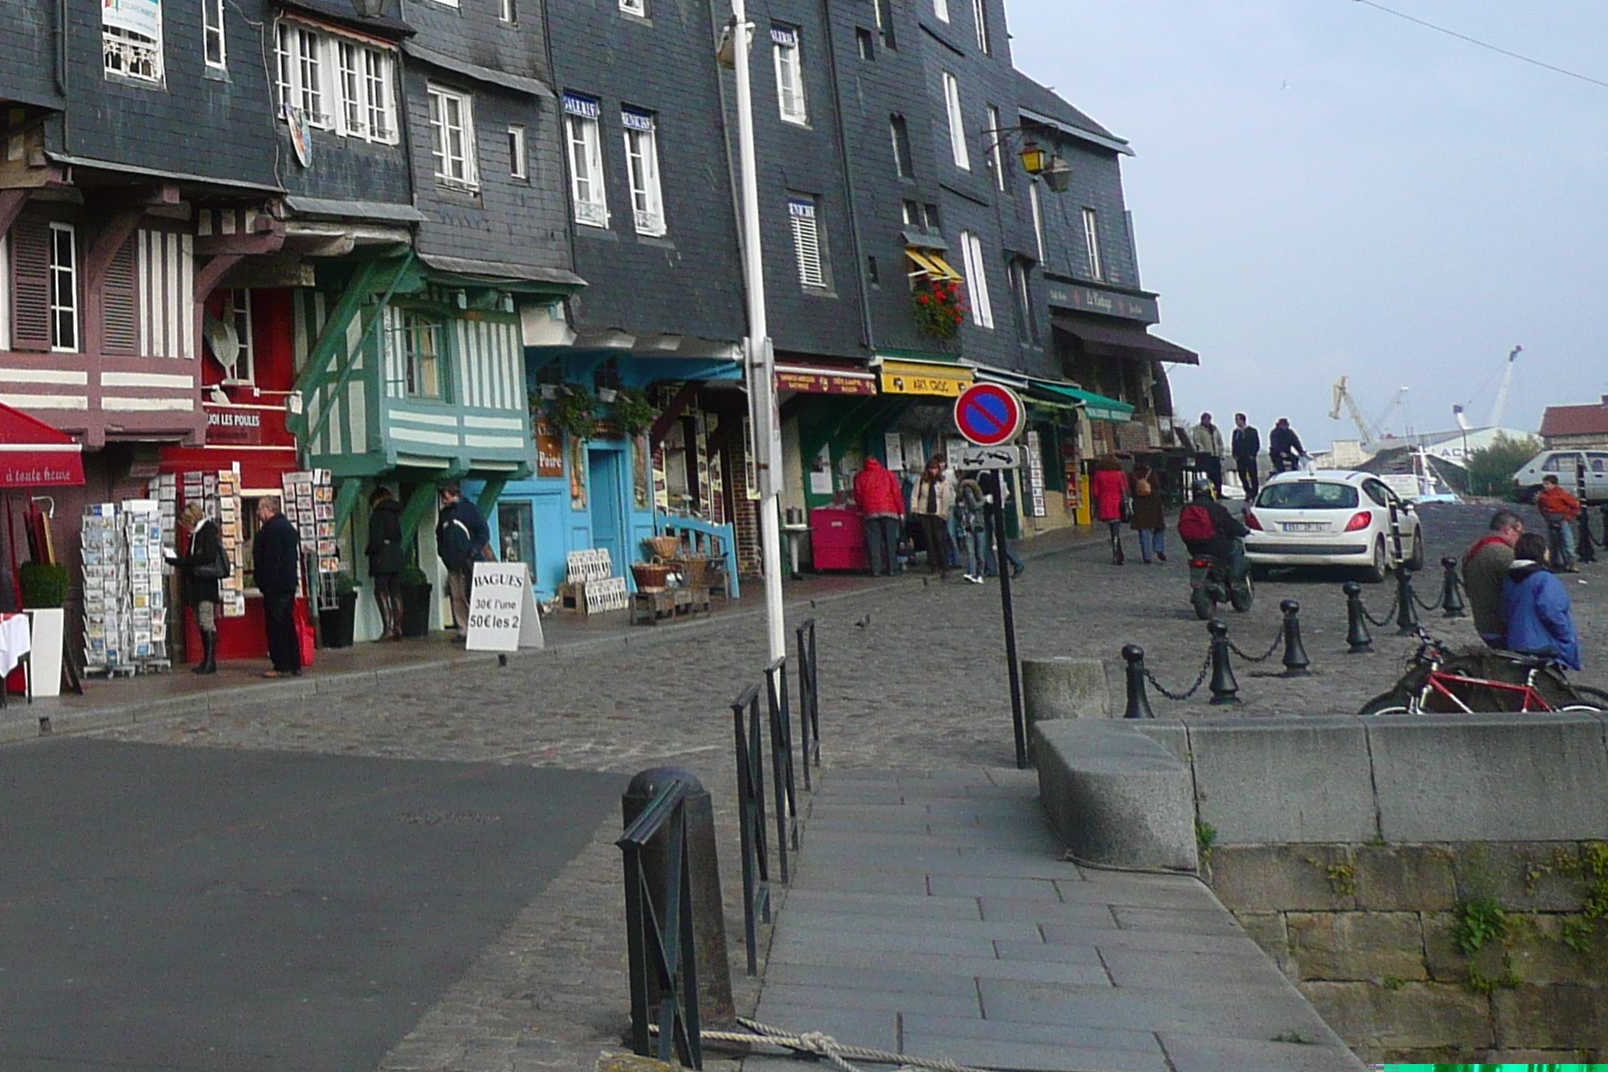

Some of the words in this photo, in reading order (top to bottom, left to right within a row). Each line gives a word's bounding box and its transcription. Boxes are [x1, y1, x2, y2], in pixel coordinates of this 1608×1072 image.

[221, 414, 233, 426] LES
[234, 414, 260, 427] POULES
[5, 466, 13, 482] à
[15, 468, 42, 482] toute
[474, 574, 524, 588] BAGUES
[475, 599, 493, 610] 30€
[495, 599, 517, 609] l'une
[469, 614, 491, 628] 50€
[493, 614, 510, 629] les
[512, 615, 519, 628] 2
